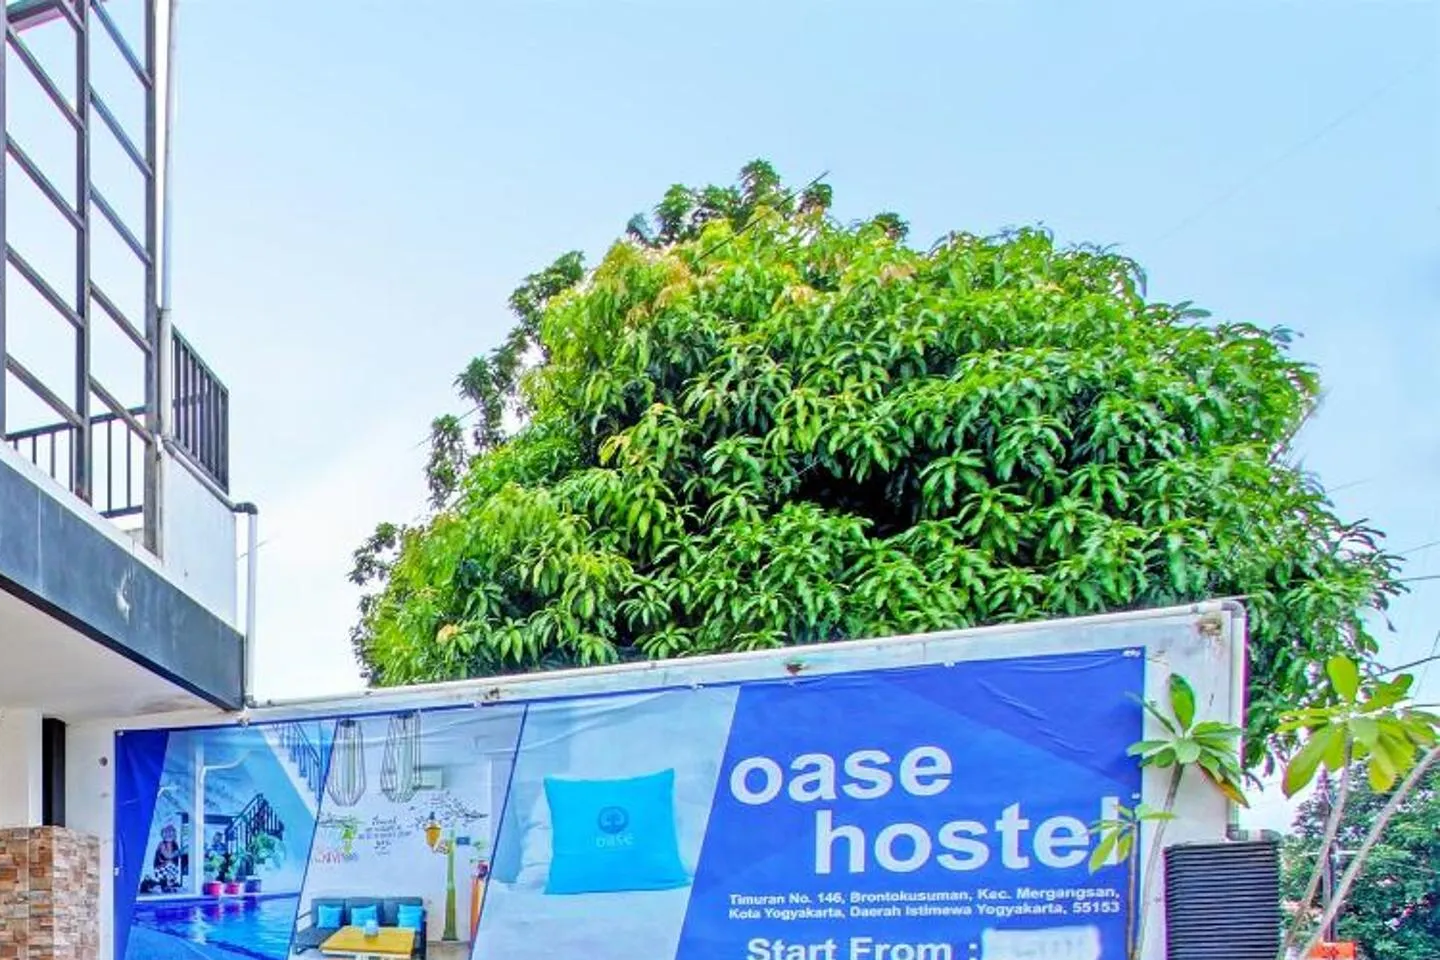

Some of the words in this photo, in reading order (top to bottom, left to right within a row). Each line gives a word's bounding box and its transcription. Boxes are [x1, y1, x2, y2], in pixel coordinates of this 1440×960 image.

[729, 745, 953, 806] oase
[815, 796, 1120, 875] hostel
[728, 908, 761, 920] Kota
[763, 905, 846, 921] Yogyakarta,
[849, 905, 902, 918] Daerah
[905, 903, 973, 917] Istimewa
[976, 901, 1068, 917] Yogyakarta,
[1072, 901, 1121, 914] 55153
[729, 893, 785, 906] Timuran
[788, 892, 812, 904] No.
[817, 891, 846, 905] 146,
[850, 889, 973, 904] Brontokusuman,
[977, 888, 1011, 900] Kec.
[1016, 886, 1120, 901] Mergangsan,
